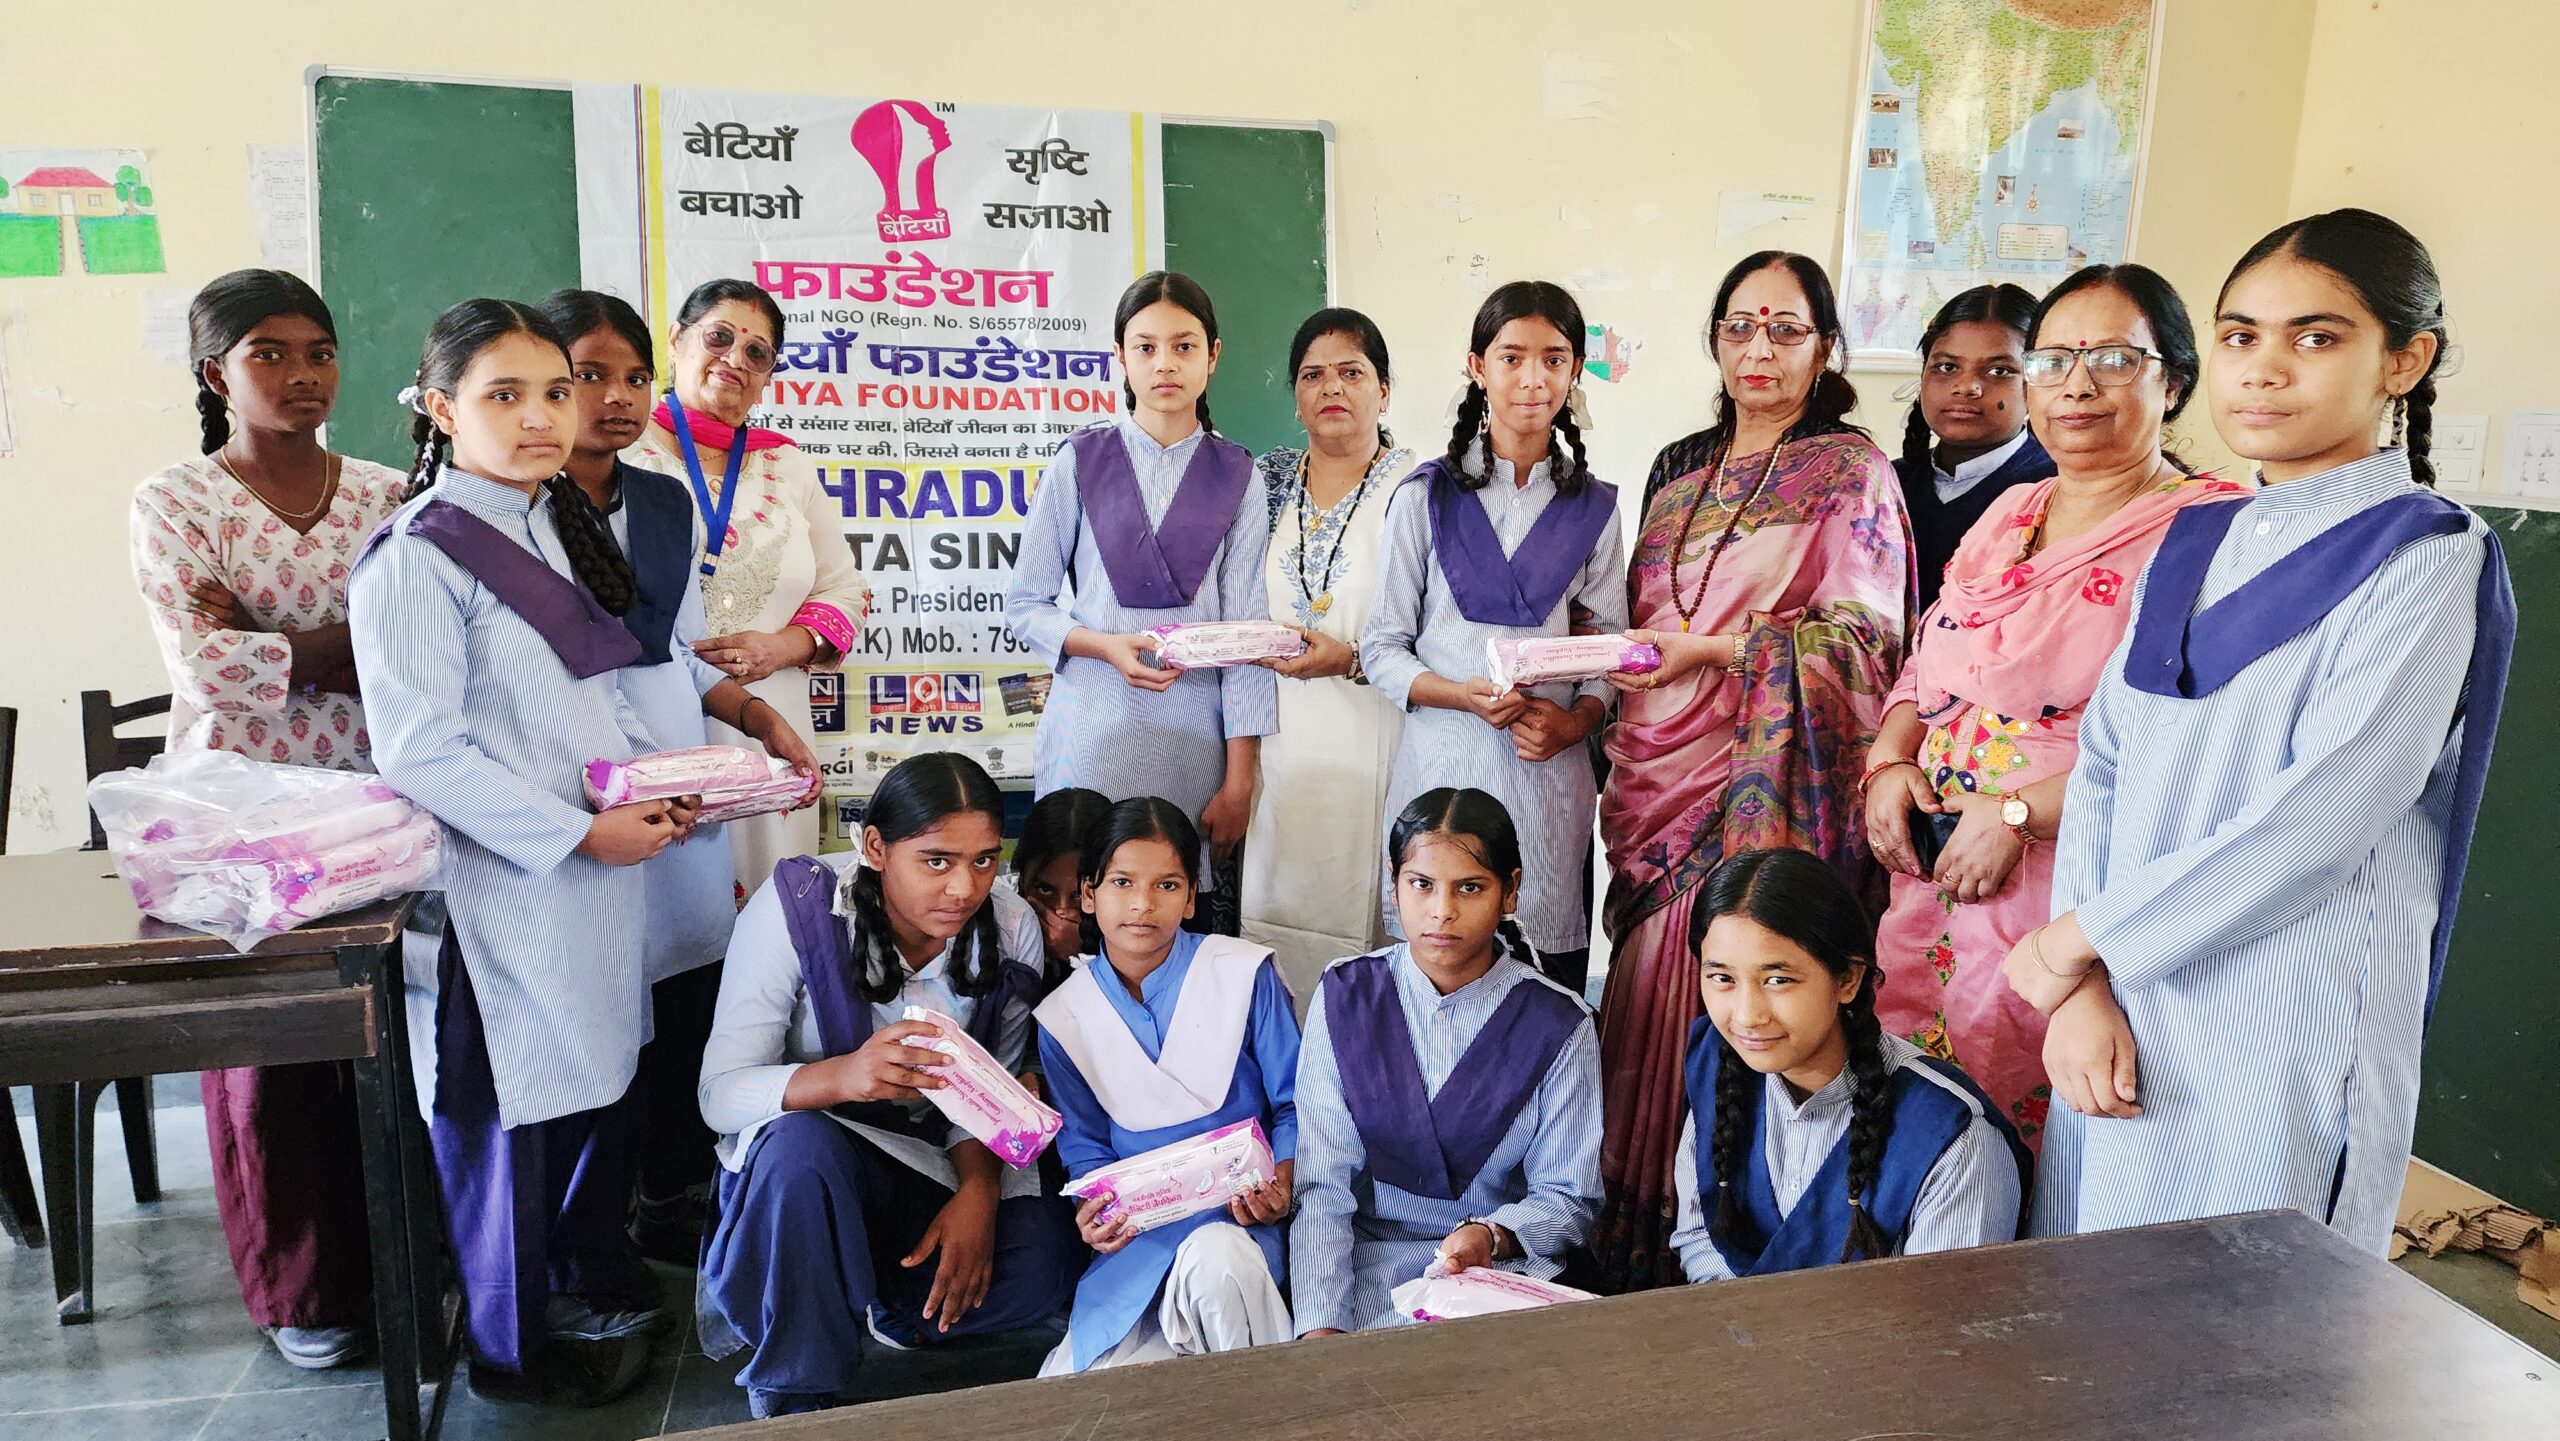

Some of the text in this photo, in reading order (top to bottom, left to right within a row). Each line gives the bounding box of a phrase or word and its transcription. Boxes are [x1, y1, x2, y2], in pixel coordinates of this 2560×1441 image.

[935, 102, 955, 113] TM
[683, 121, 799, 162] बेटियाँ
[1005, 137, 1090, 186] सृष्टि
[679, 184, 803, 220] बचाओ
[982, 198, 1112, 233] सजाओ
[879, 211, 946, 238] बेटियाँ
[752, 250, 1054, 308] फाउंडेशन
[821, 309, 864, 324] NGO
[870, 311, 927, 330] (Regn.
[934, 313, 963, 329] No.
[969, 315, 1087, 335] S/65578/2009)
[867, 336, 1115, 383] फाउंडेशन
[857, 382, 1116, 414] FOUNDATION
[776, 413, 794, 430] से
[798, 414, 850, 431] संसार
[903, 417, 953, 434] बेटियाँ
[956, 419, 1007, 434] जीवन
[1012, 422, 1037, 434] का
[834, 444, 863, 456] घर
[904, 441, 959, 459] जिससे
[964, 446, 1010, 459] बनता
[1016, 442, 1029, 459] है
[929, 532, 1022, 571] SIN
[892, 586, 1008, 614] Presiden
[903, 626, 962, 654] Mob.
[870, 715, 984, 735] NEWS
[1016, 720, 1035, 729] Hindi
[820, 760, 853, 776] RGI
